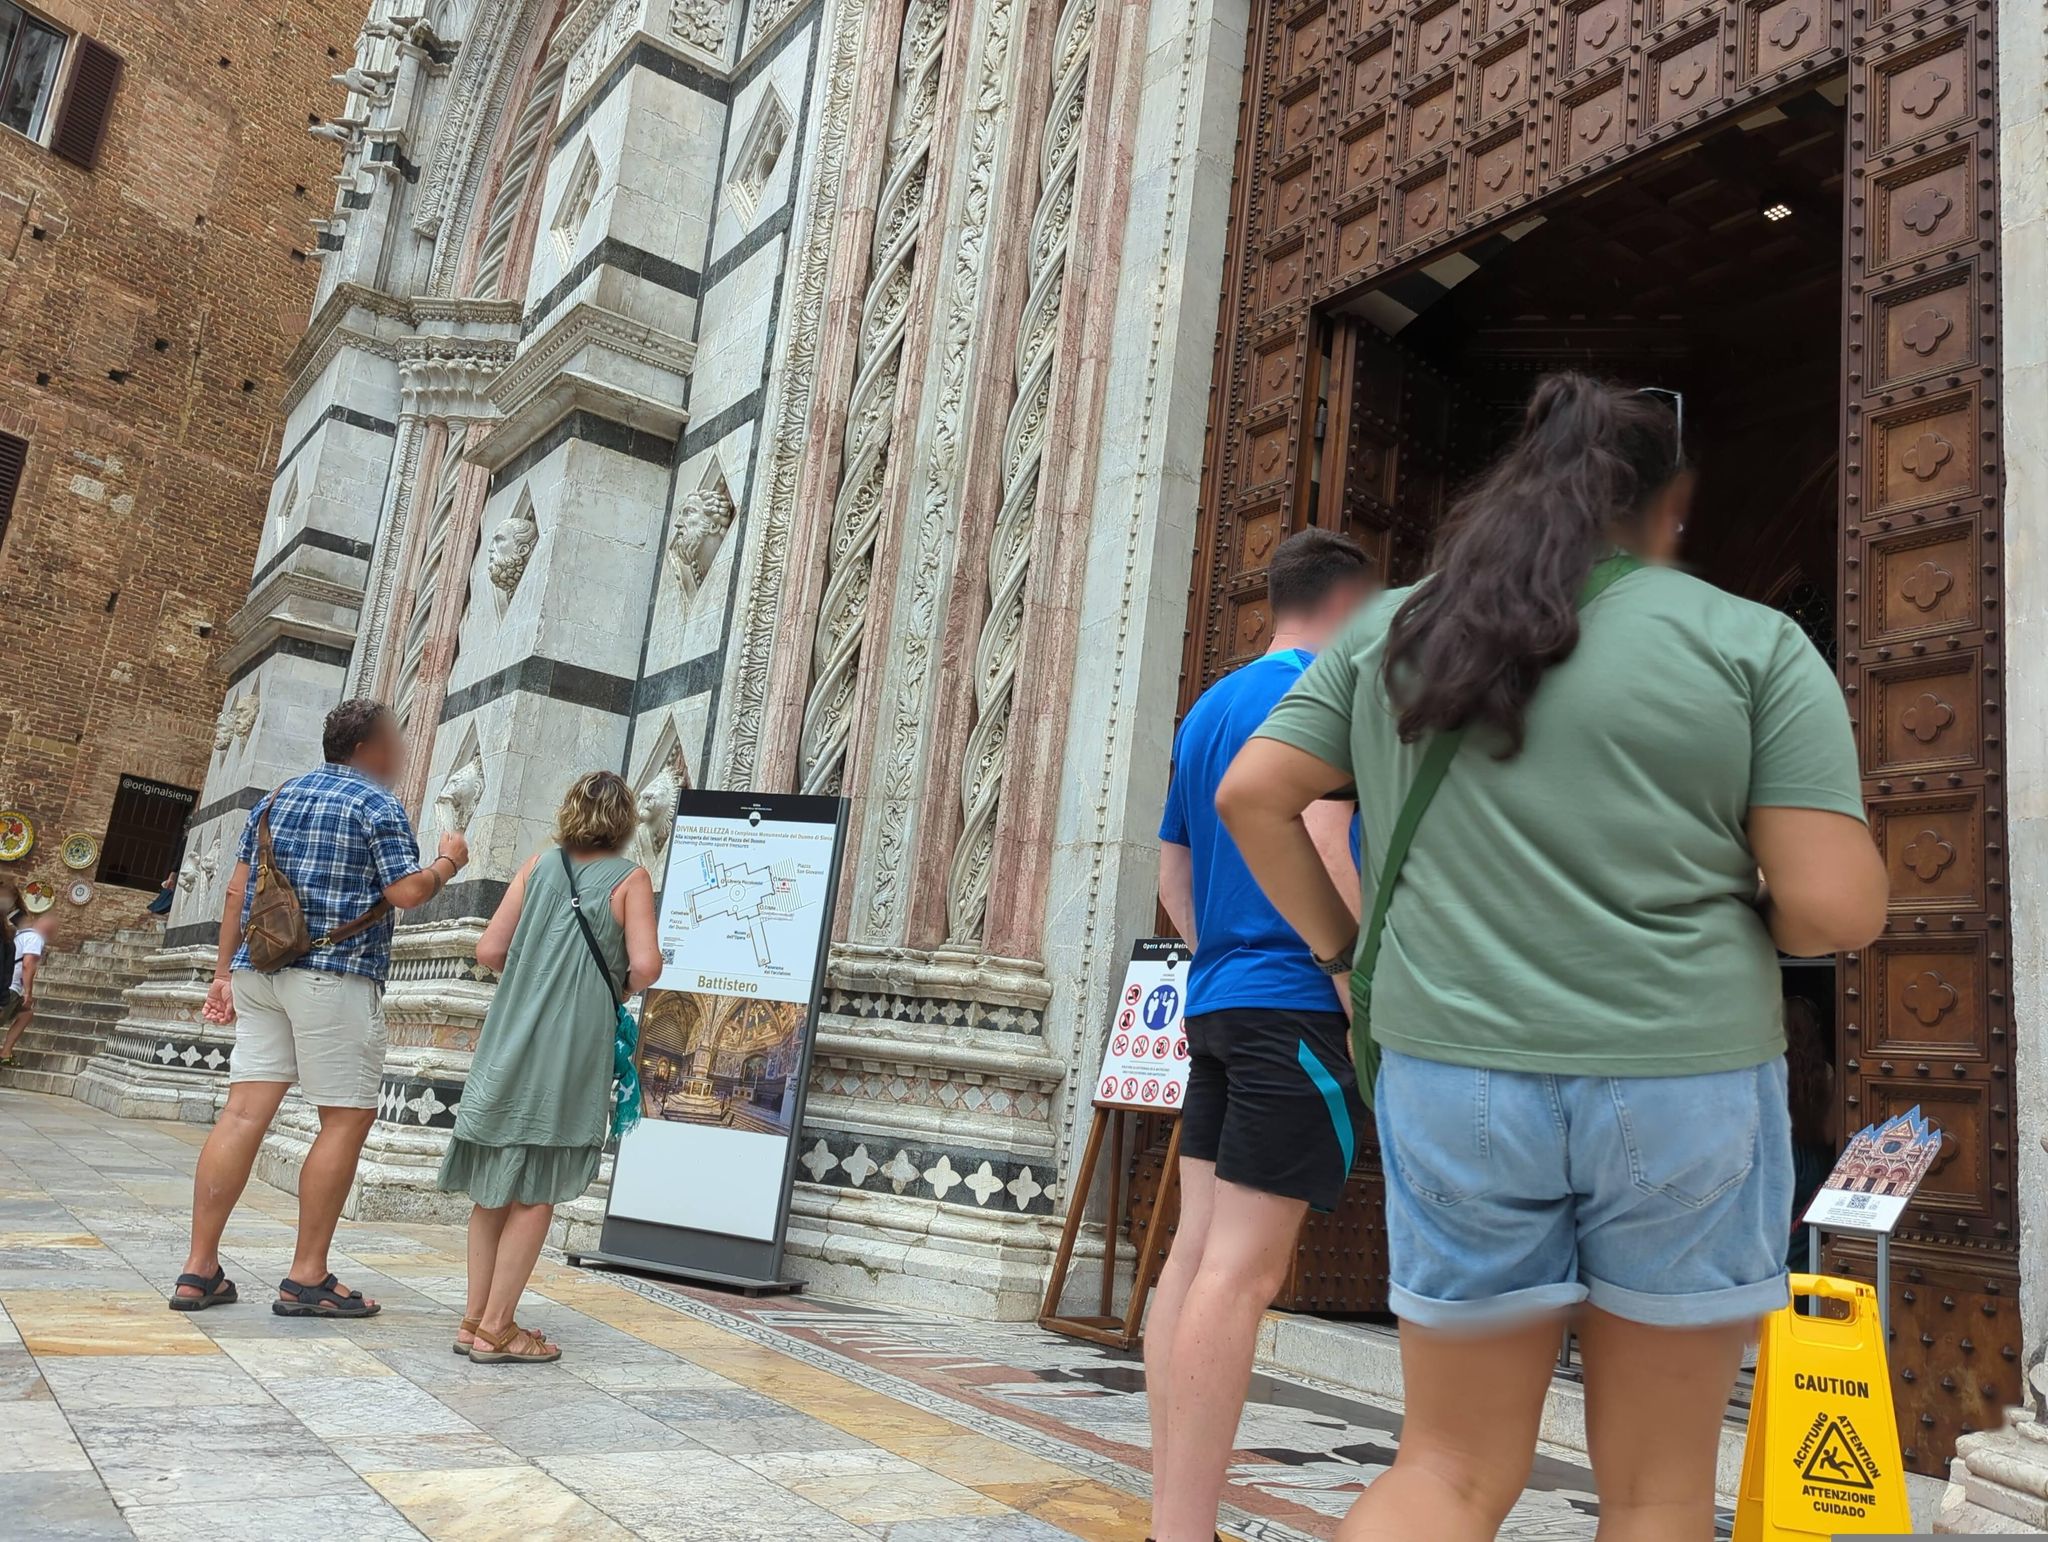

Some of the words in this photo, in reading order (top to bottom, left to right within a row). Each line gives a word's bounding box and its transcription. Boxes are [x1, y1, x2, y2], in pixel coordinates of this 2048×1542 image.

[122, 778, 193, 802] @originalsiena
[676, 825, 698, 833] DIVINA
[699, 826, 730, 835] BELLEZZA
[759, 831, 789, 839] Monumentale
[1142, 942, 1158, 950] Opera
[1159, 942, 1173, 950] della
[697, 975, 758, 993] Battistero
[1794, 1373, 1869, 1399] CAUTION
[1792, 1411, 1829, 1470] ACHTUNG
[1836, 1414, 1882, 1480] ATTENTION
[1802, 1485, 1876, 1506] ATTENZIONE
[1813, 1500, 1866, 1519] CUIDADO
